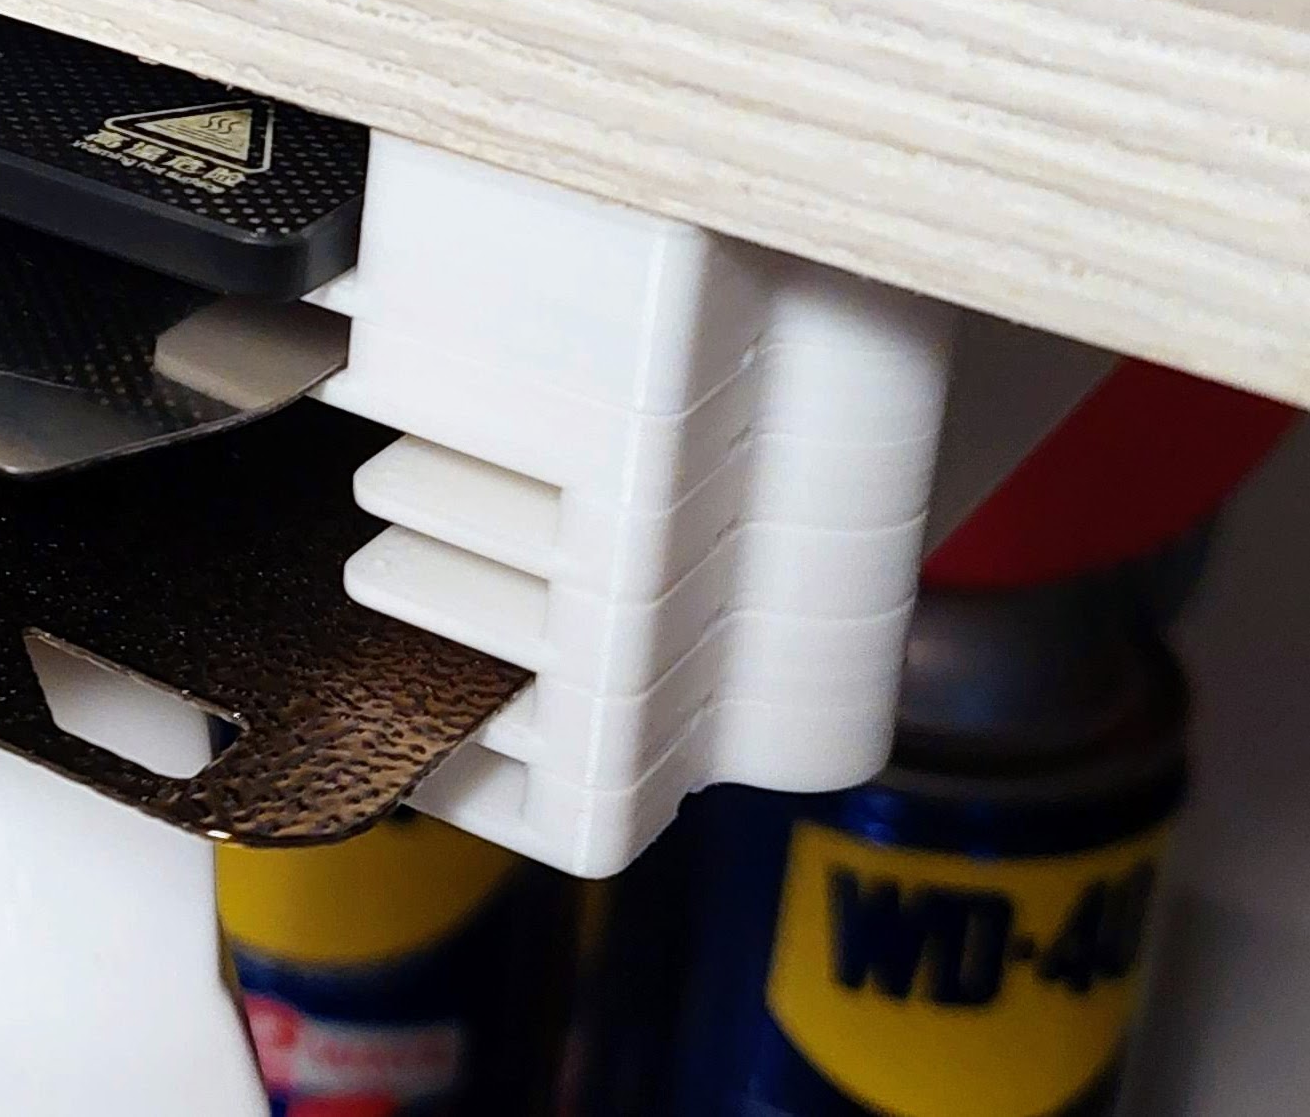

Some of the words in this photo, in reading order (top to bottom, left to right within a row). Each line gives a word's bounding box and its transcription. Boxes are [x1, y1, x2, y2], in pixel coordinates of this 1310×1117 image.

[71, 139, 138, 167] Warning
[137, 161, 167, 176] hot
[165, 170, 226, 194] surface
